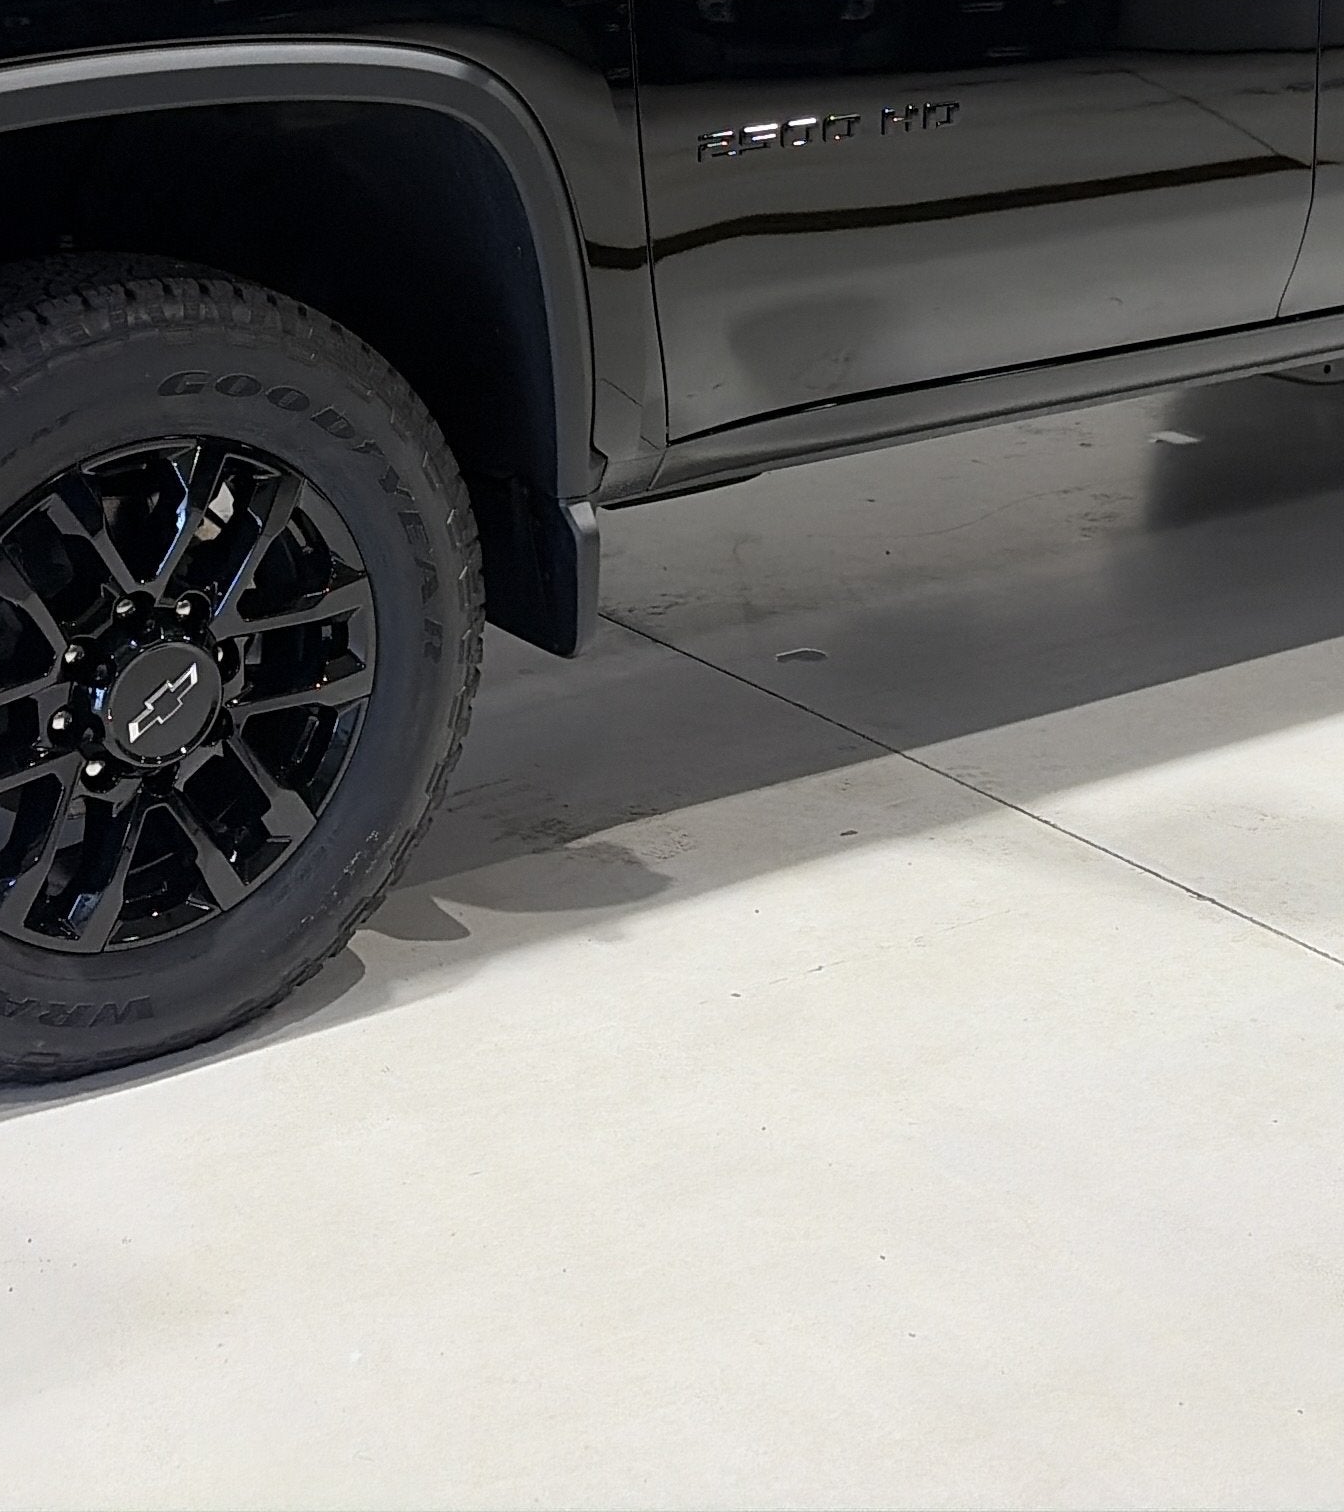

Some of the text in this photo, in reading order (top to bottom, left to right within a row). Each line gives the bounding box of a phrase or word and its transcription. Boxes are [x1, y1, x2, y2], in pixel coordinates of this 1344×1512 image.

[697, 101, 960, 163] 2500 HD
[157, 369, 446, 665] GOODYEAR
